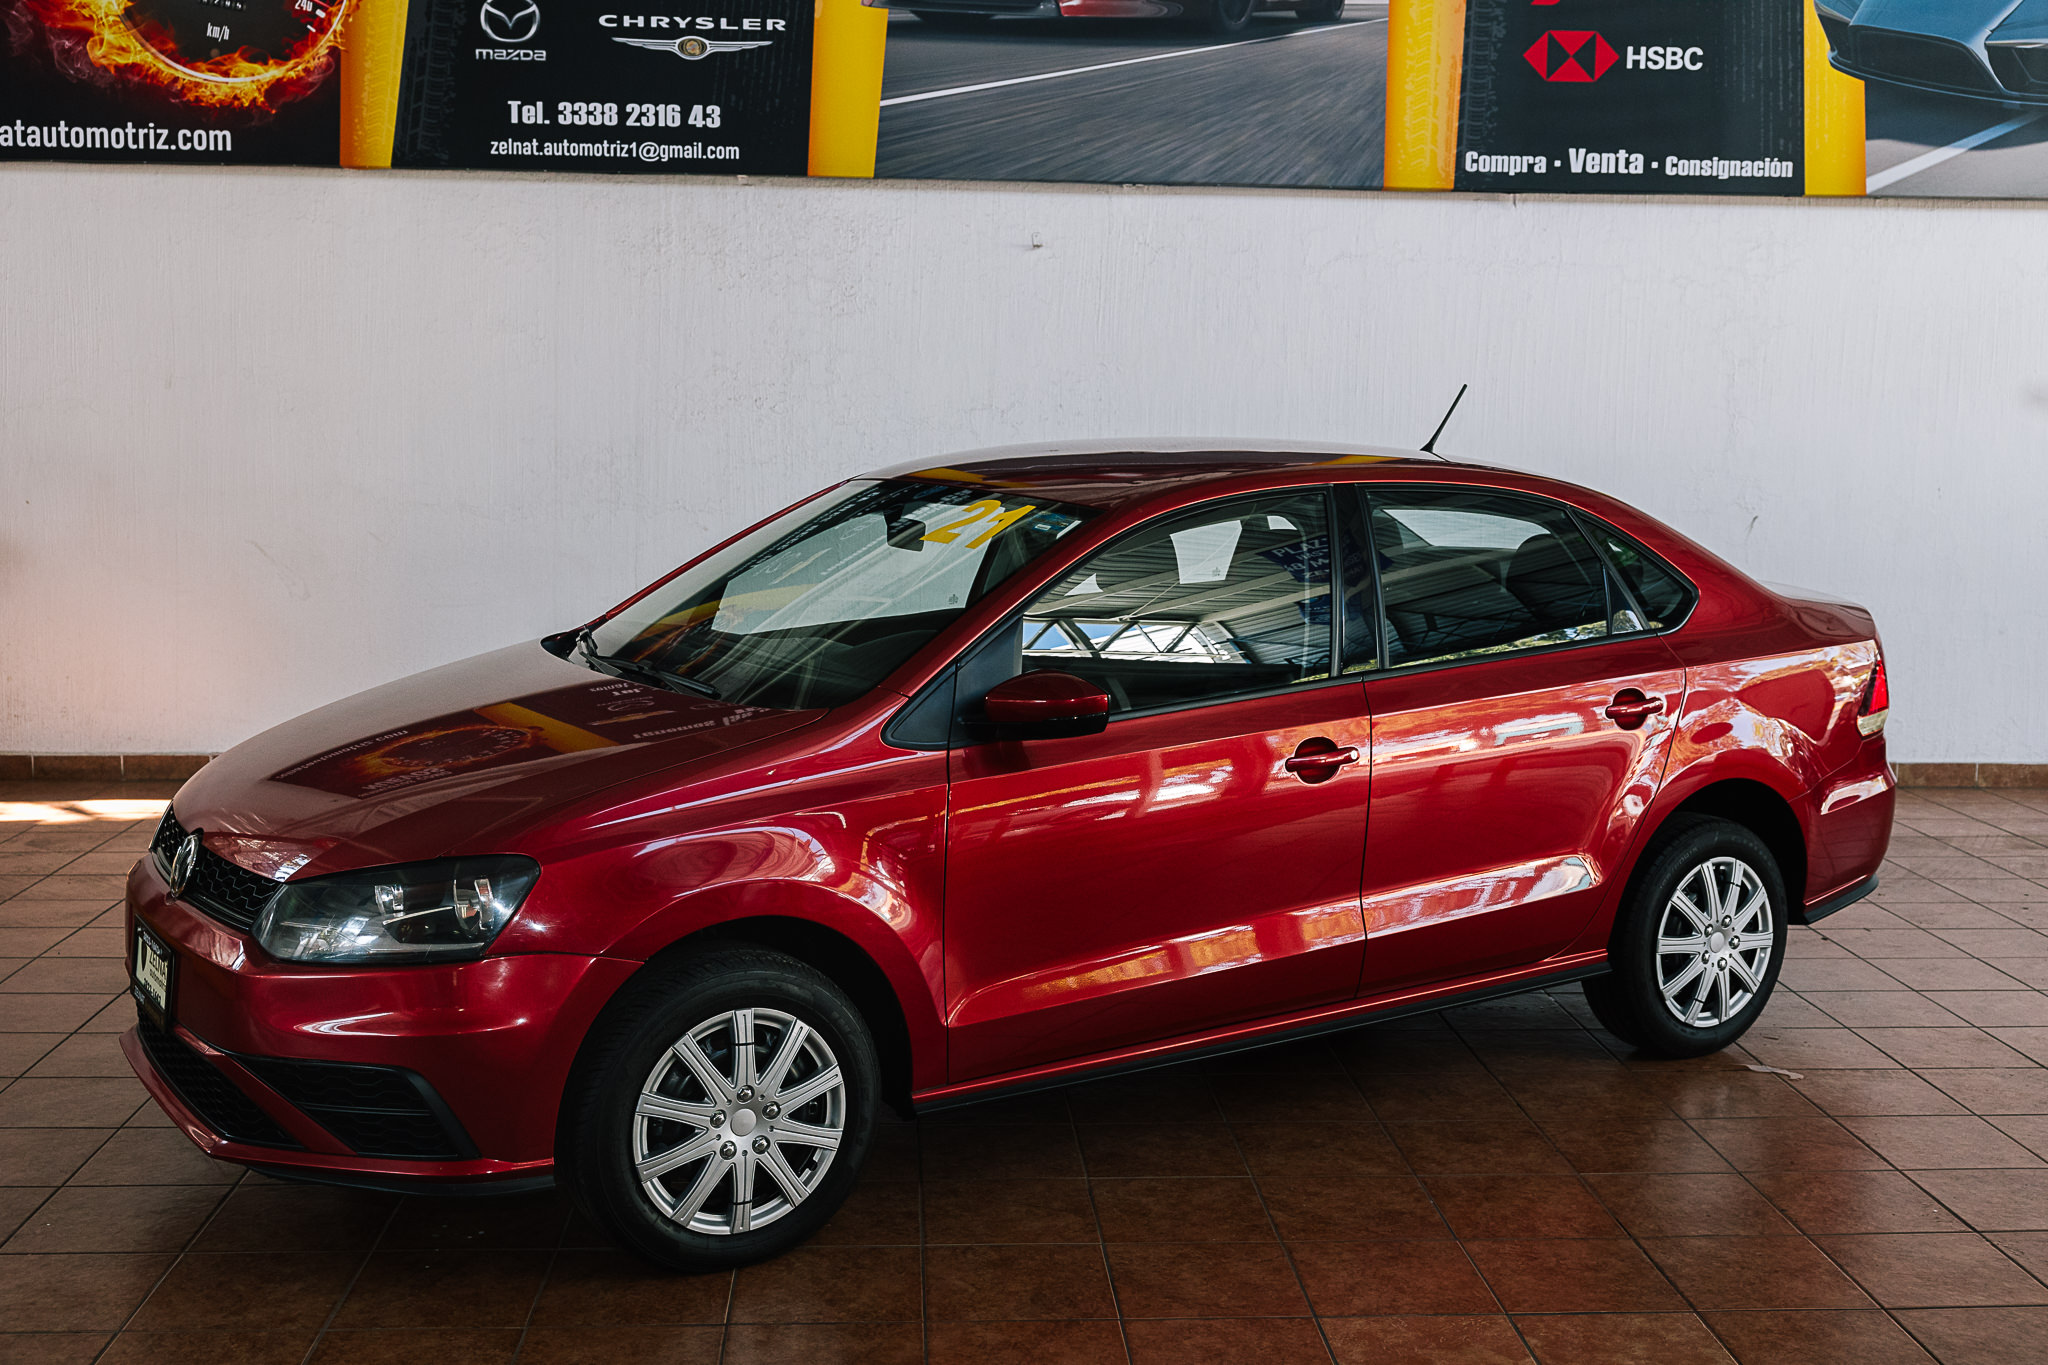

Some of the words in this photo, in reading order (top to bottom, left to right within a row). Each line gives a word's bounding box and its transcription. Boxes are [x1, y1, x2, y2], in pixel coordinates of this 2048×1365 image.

[206, 22, 230, 42] km/h
[598, 14, 787, 31] CHRYSLER
[1625, 45, 1704, 71] HSBC
[507, 100, 551, 125] Tel.
[557, 101, 619, 127] 3338
[625, 103, 681, 128] 2316
[687, 104, 721, 129] 43
[0, 119, 232, 152] atautomotriz.com
[490, 137, 740, 162] zelnat.automotriz1@gmail.com
[1464, 150, 1547, 177] Compra
[1568, 147, 1644, 175] Venta
[1664, 155, 1794, 180] Consignación
[919, 499, 1036, 549] 21
